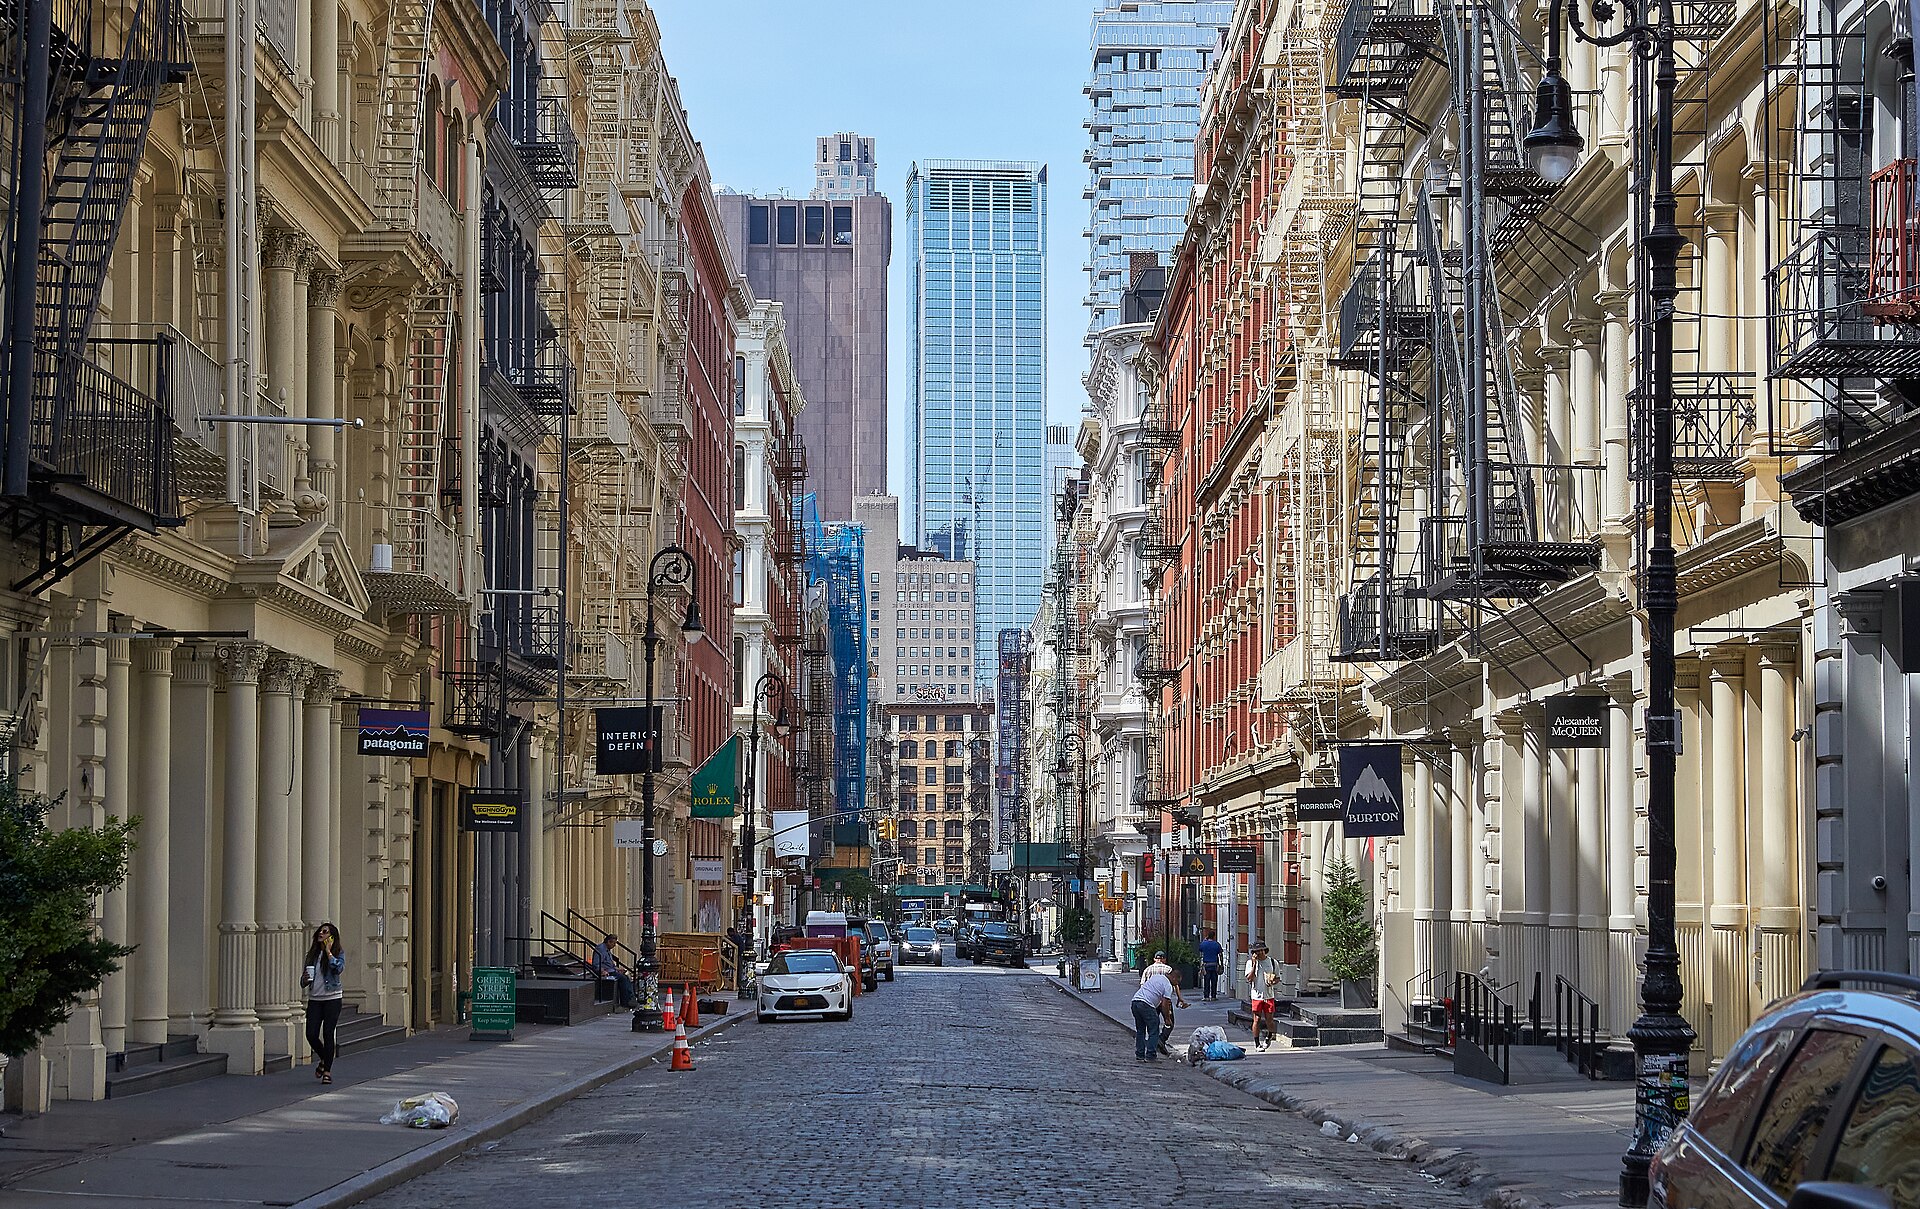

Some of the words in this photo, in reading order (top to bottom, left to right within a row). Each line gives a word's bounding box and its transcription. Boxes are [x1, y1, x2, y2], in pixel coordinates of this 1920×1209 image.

[1554, 716, 1599, 725] Alexander
[1551, 726, 1603, 739] McQUEEN
[363, 739, 423, 751] patagonia
[608, 742, 644, 750] DEFIN
[694, 797, 730, 805] ROLEX
[1349, 812, 1398, 823] BURTON
[777, 840, 805, 853] Rails
[476, 976, 511, 984] GREENE
